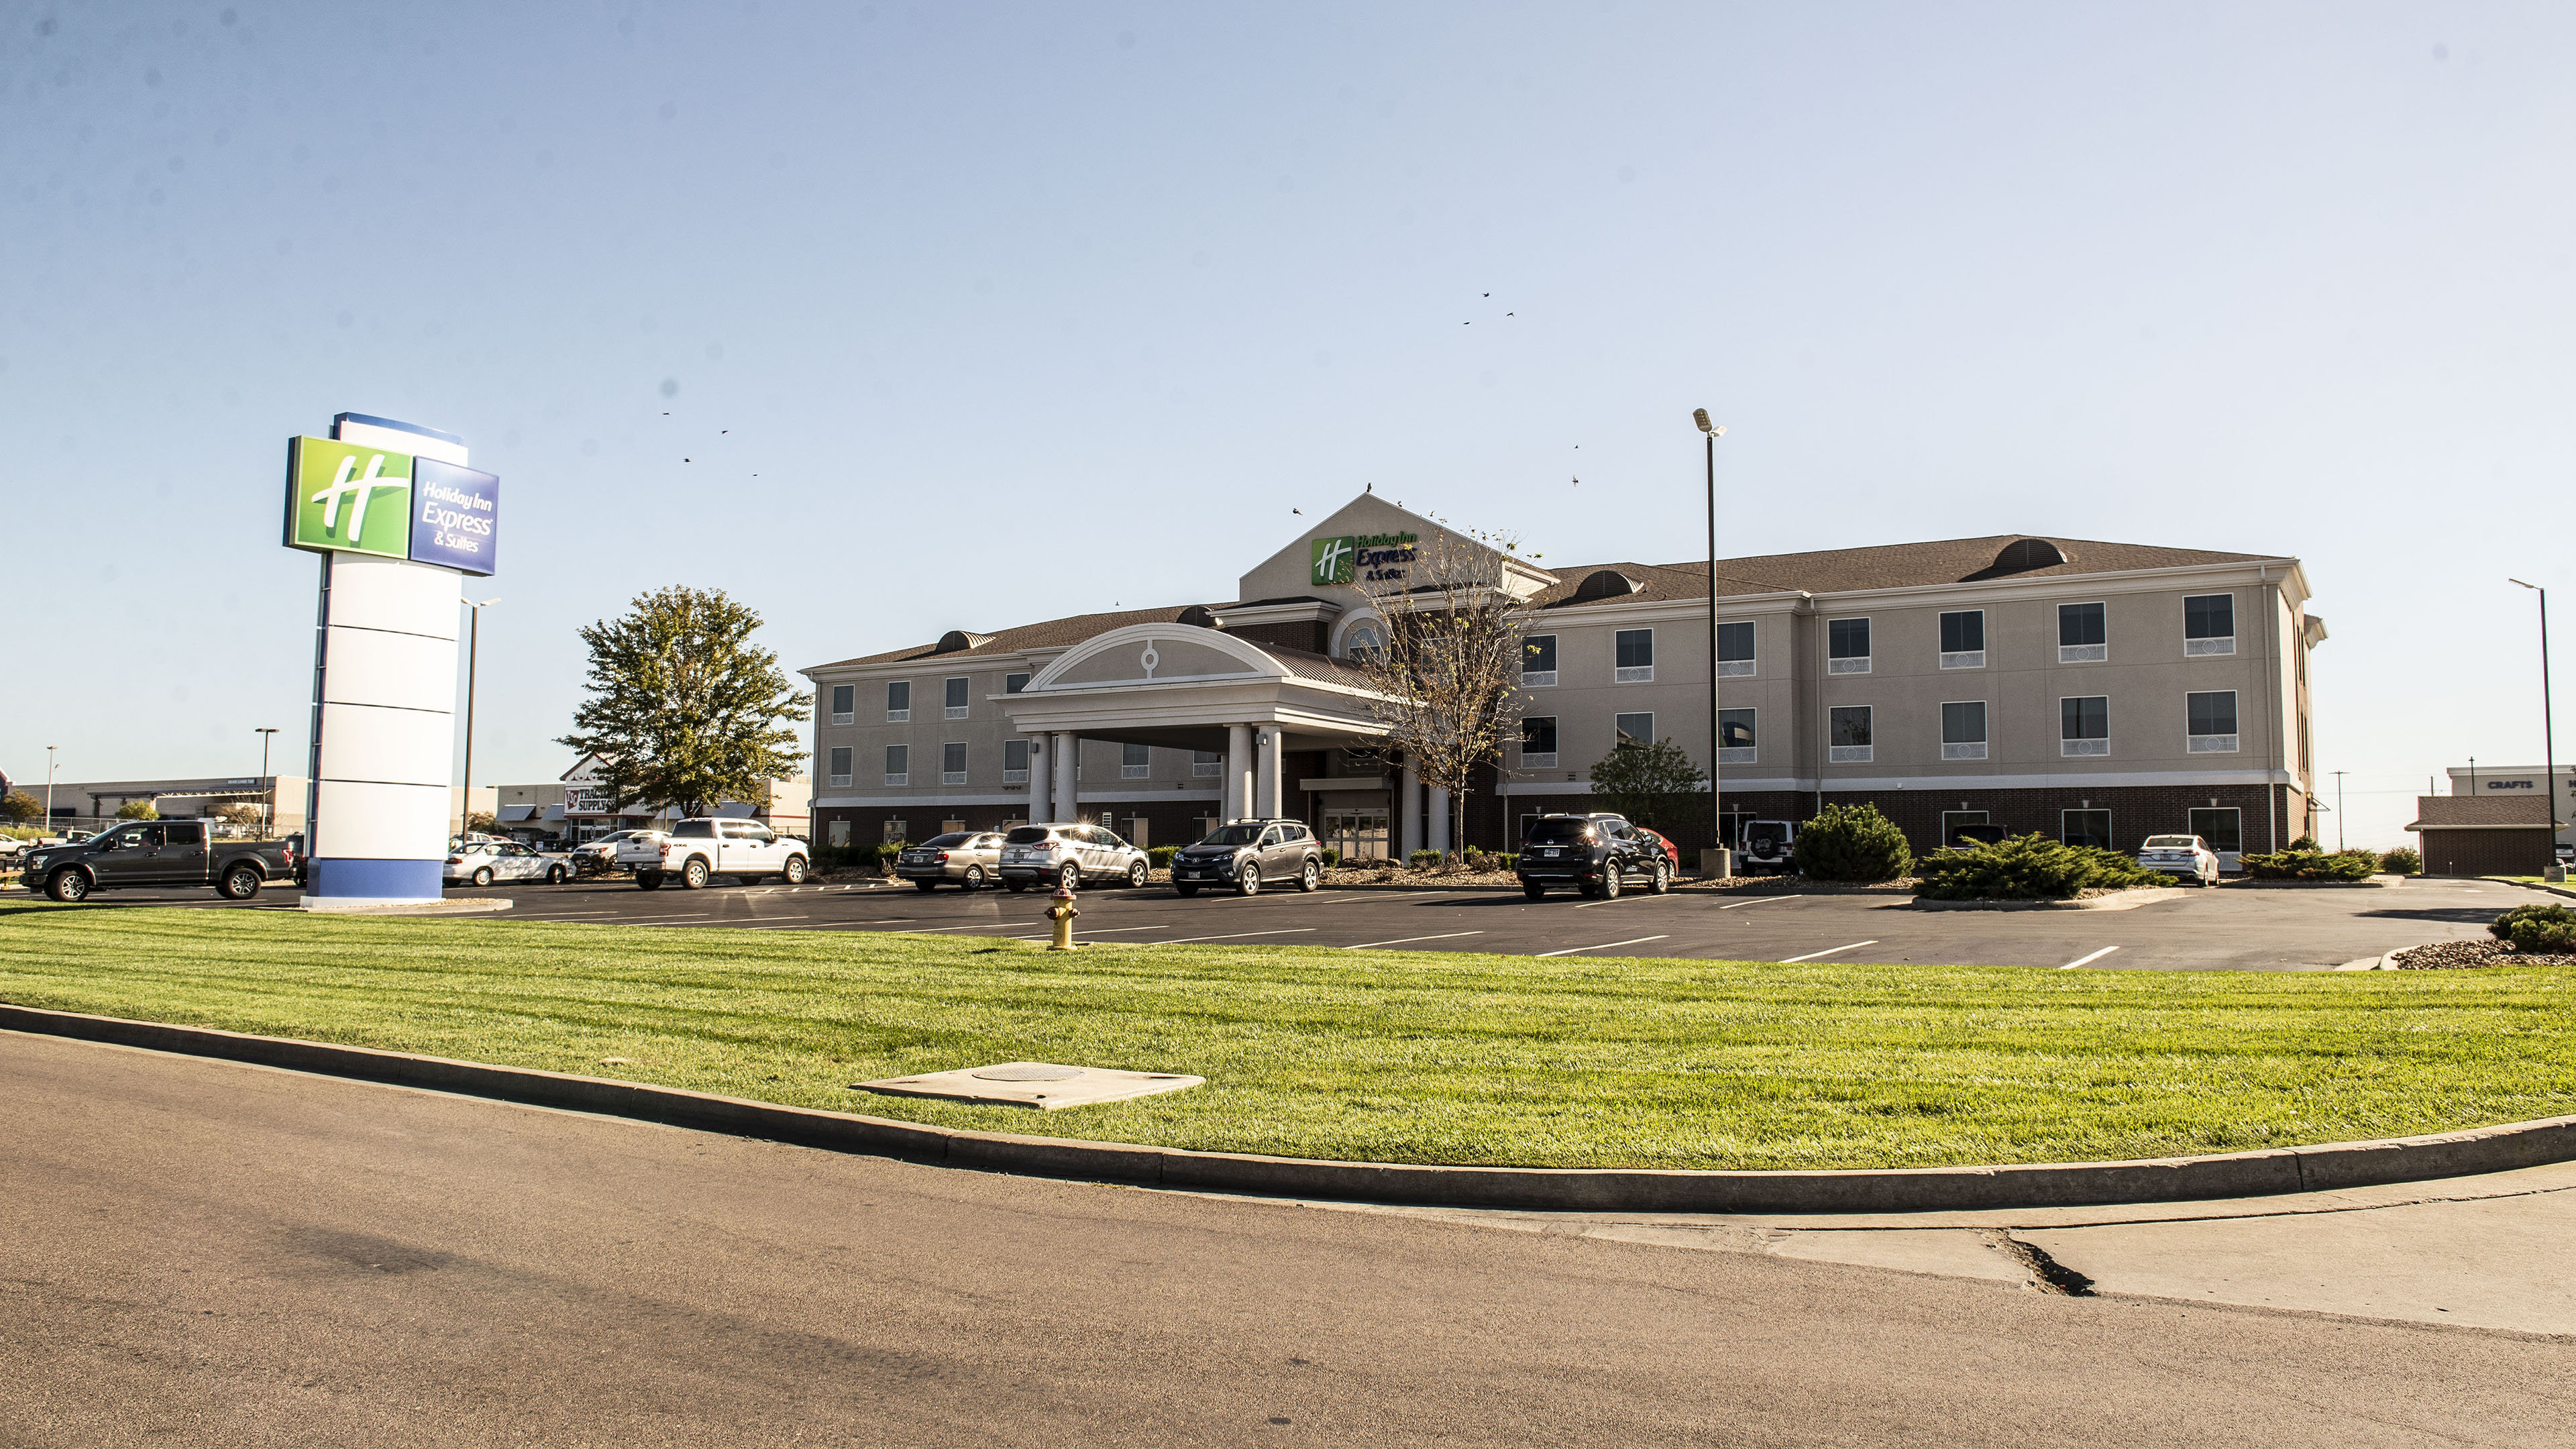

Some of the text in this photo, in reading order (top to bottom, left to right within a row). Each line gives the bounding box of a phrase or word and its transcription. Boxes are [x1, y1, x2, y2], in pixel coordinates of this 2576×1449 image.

[423, 481, 492, 512] Holiday Inn
[422, 501, 492, 536] Express
[434, 531, 479, 553] & Suites
[1356, 531, 1417, 548] Holiday Inn
[1356, 546, 1417, 570] Express
[1366, 570, 1375, 582] &
[2487, 781, 2534, 790] CRAFTS
[567, 790, 577, 806] TSC
[579, 800, 606, 811] SUPPLY
